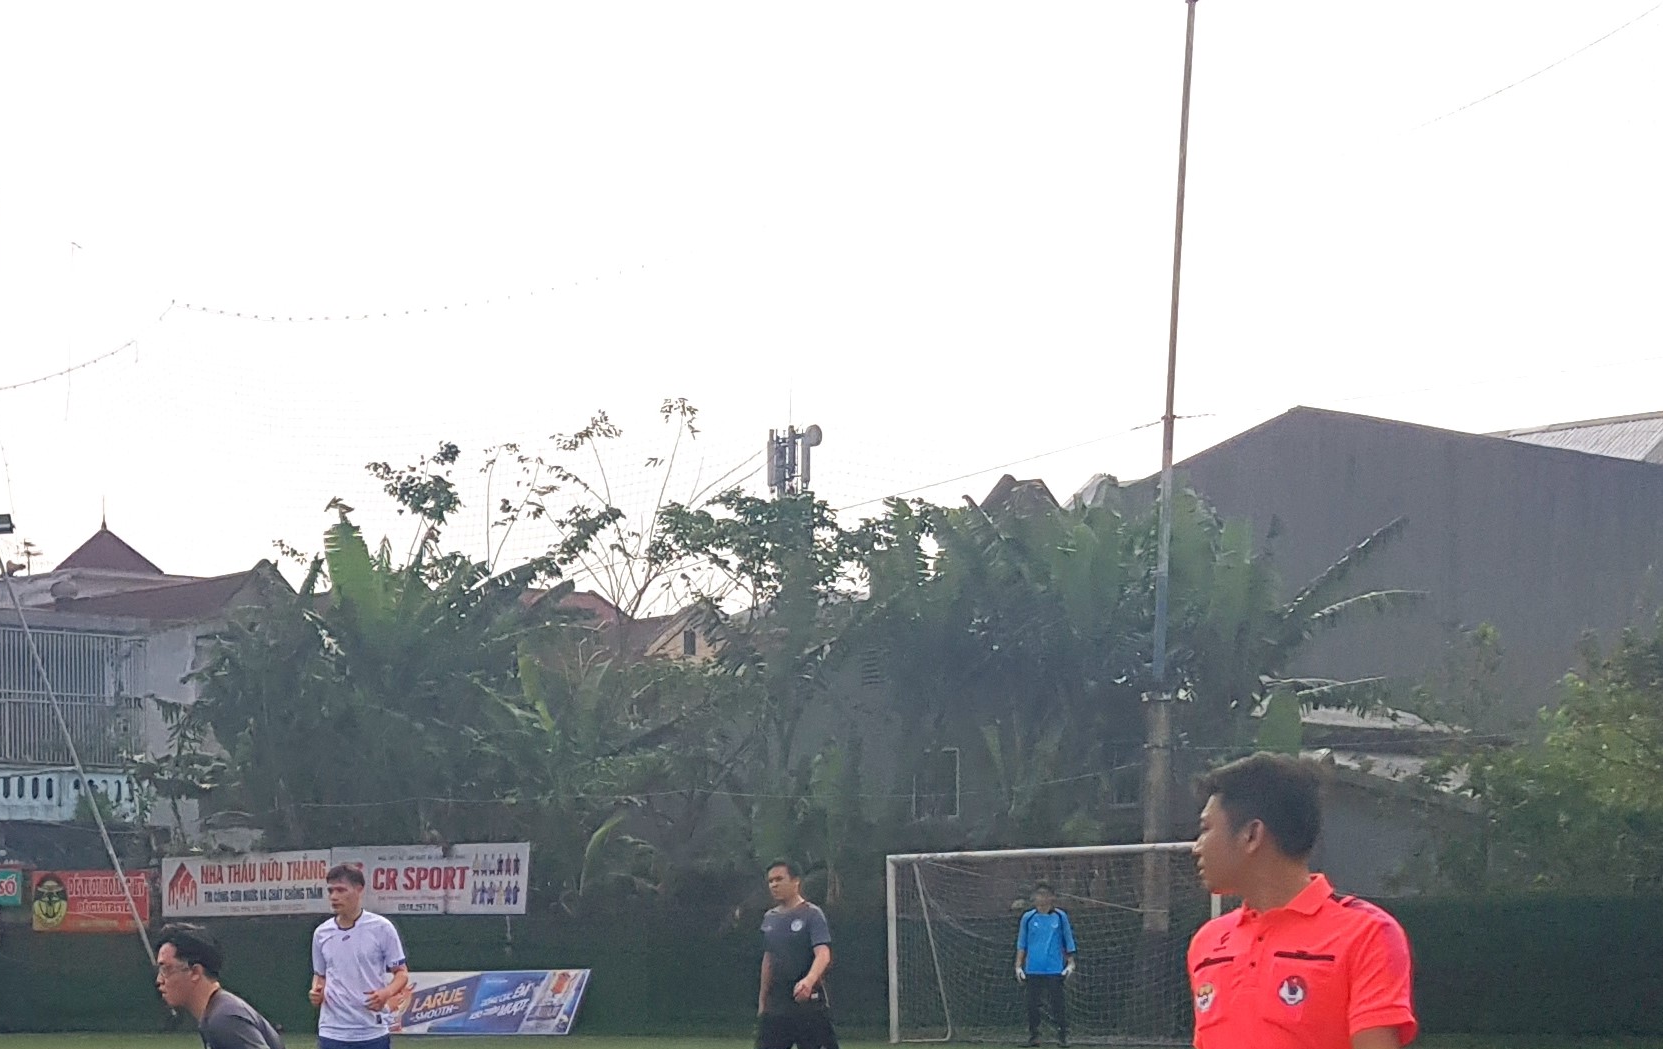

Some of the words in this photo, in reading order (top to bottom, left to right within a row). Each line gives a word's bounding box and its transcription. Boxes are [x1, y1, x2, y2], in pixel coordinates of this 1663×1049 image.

[372, 867, 398, 891] CR
[402, 866, 470, 891] SPORT
[411, 985, 468, 1013] LARUE
